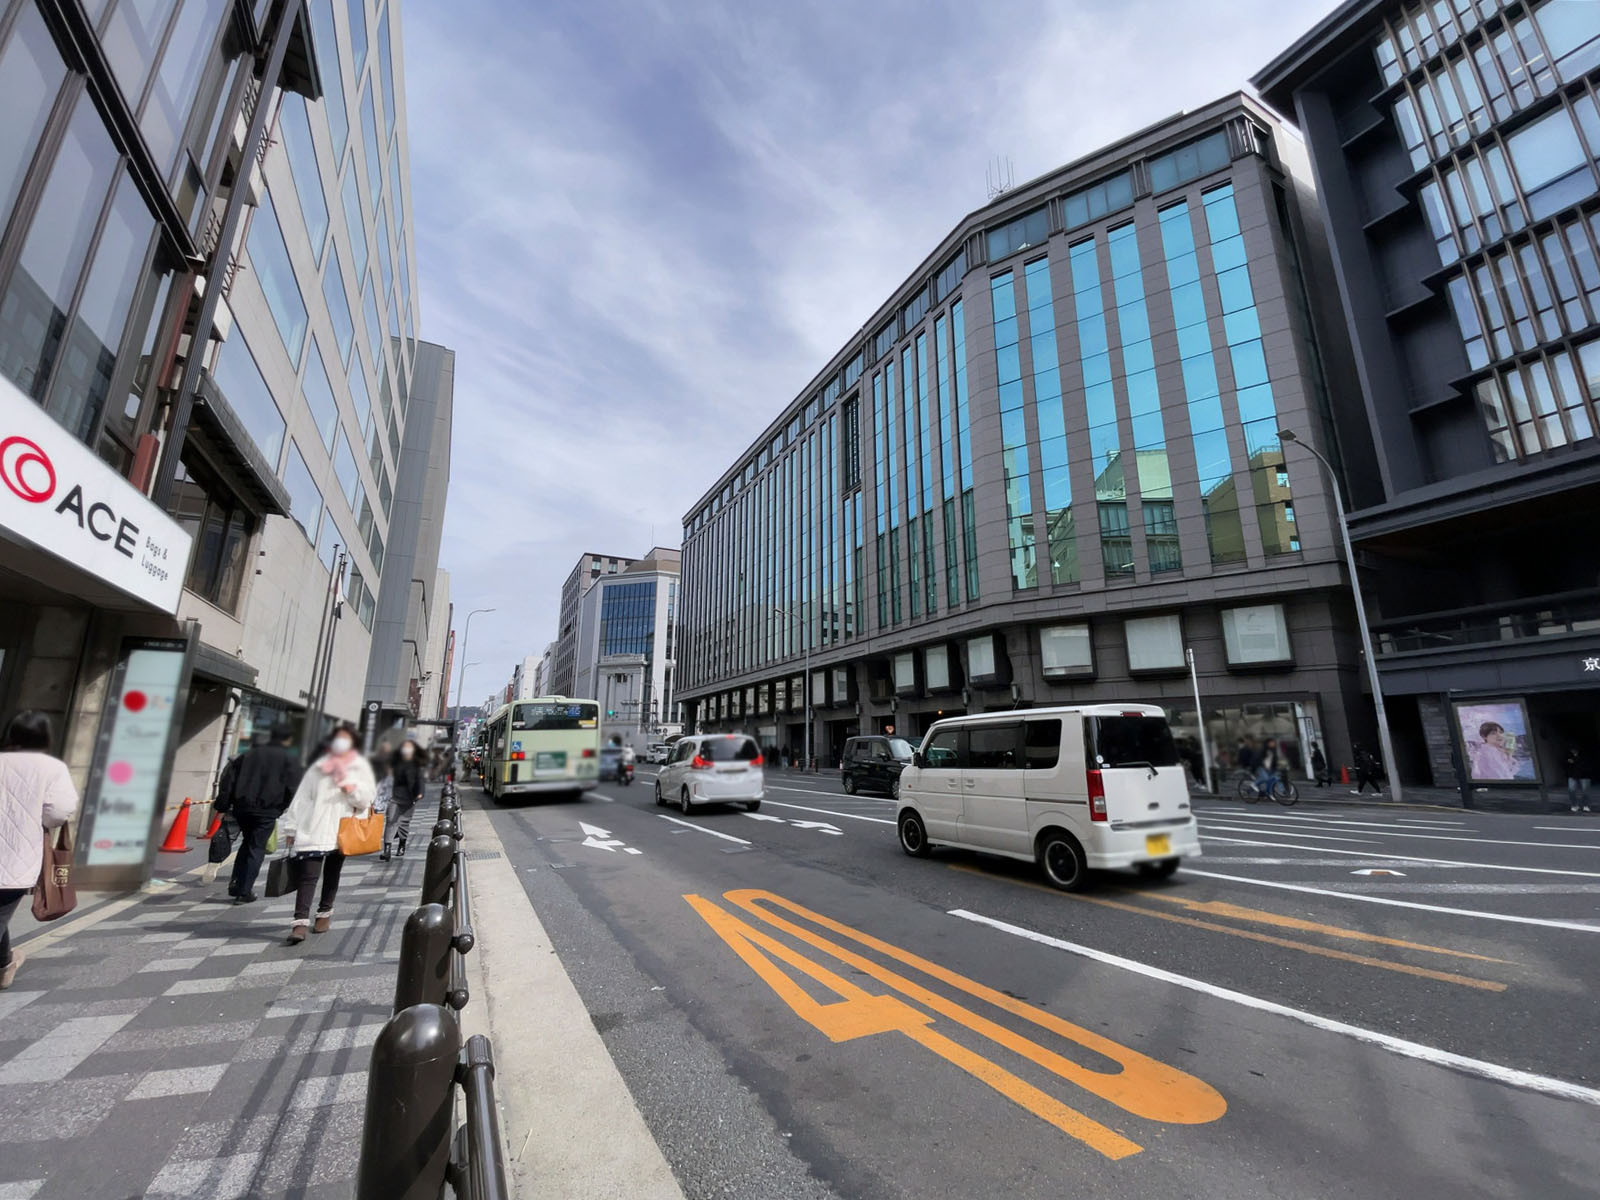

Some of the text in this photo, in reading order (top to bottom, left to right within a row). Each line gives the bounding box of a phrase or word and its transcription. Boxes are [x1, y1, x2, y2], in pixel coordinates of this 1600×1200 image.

[55, 484, 140, 559] ACE
[145, 536, 168, 560] Bags &
[141, 554, 168, 581] Luggage
[1582, 657, 1600, 672] 京
[682, 889, 1228, 1161] 40
